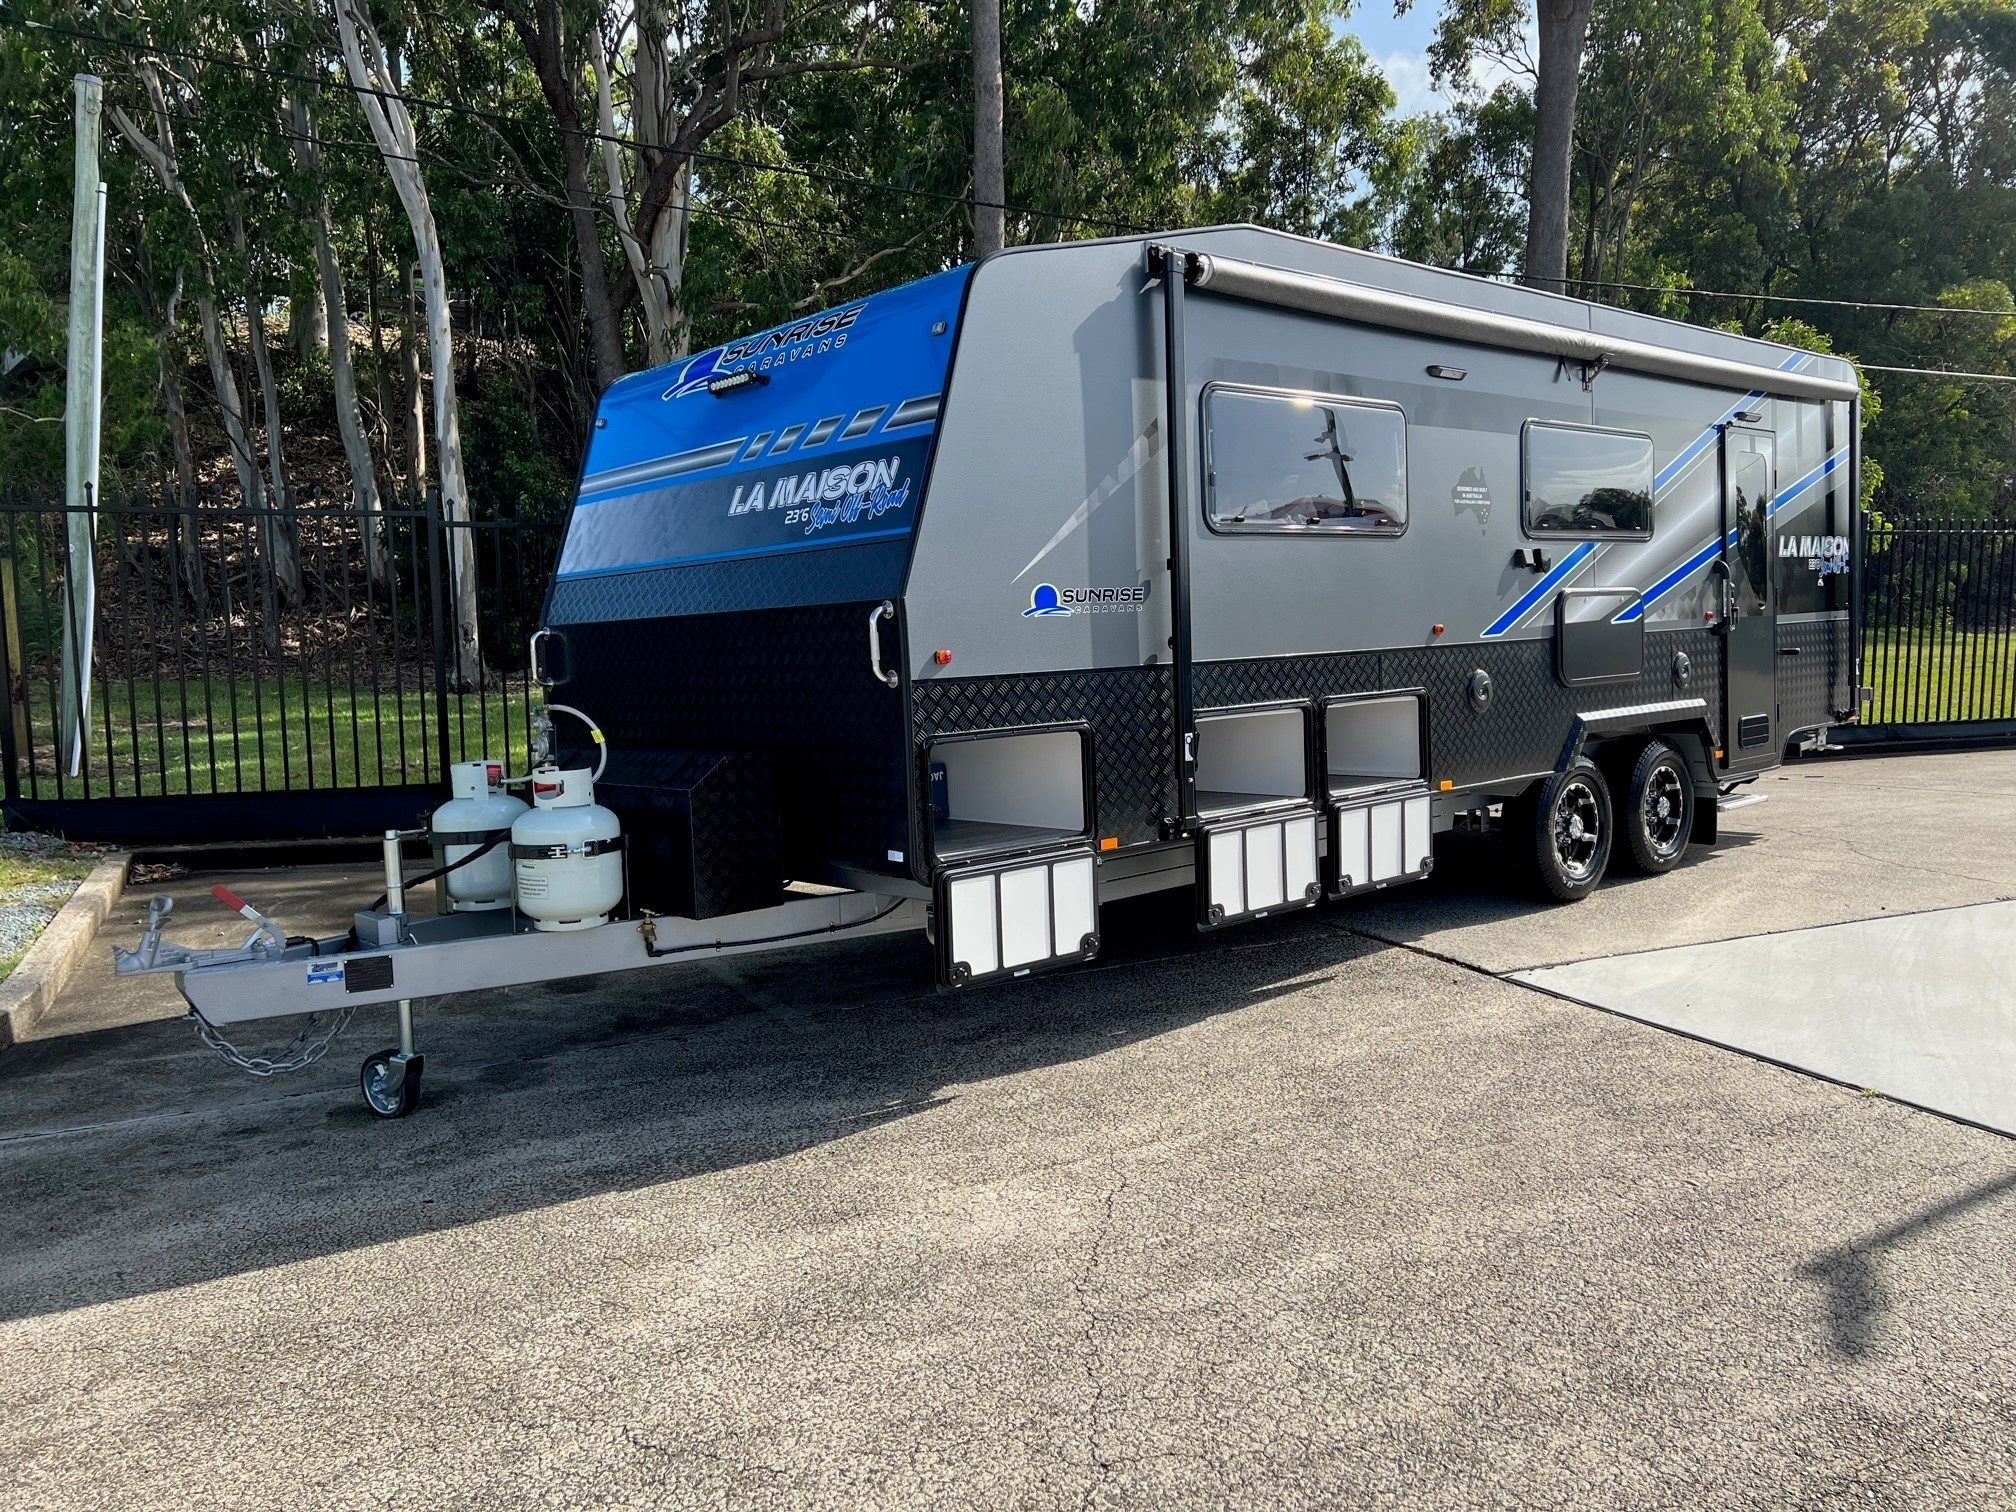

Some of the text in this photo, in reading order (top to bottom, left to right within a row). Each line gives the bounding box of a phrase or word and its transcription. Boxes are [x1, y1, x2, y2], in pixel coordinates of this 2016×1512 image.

[722, 303, 869, 365] SUNRISE
[734, 334, 848, 374] CARAVANS
[728, 456, 901, 517] LA MAISON
[784, 478, 911, 535] 23'6 Semi Off-Road
[1778, 535, 1850, 558] LA MAISON
[1062, 587, 1144, 604] SUNRISE
[1074, 604, 1143, 614] CARAVANS
